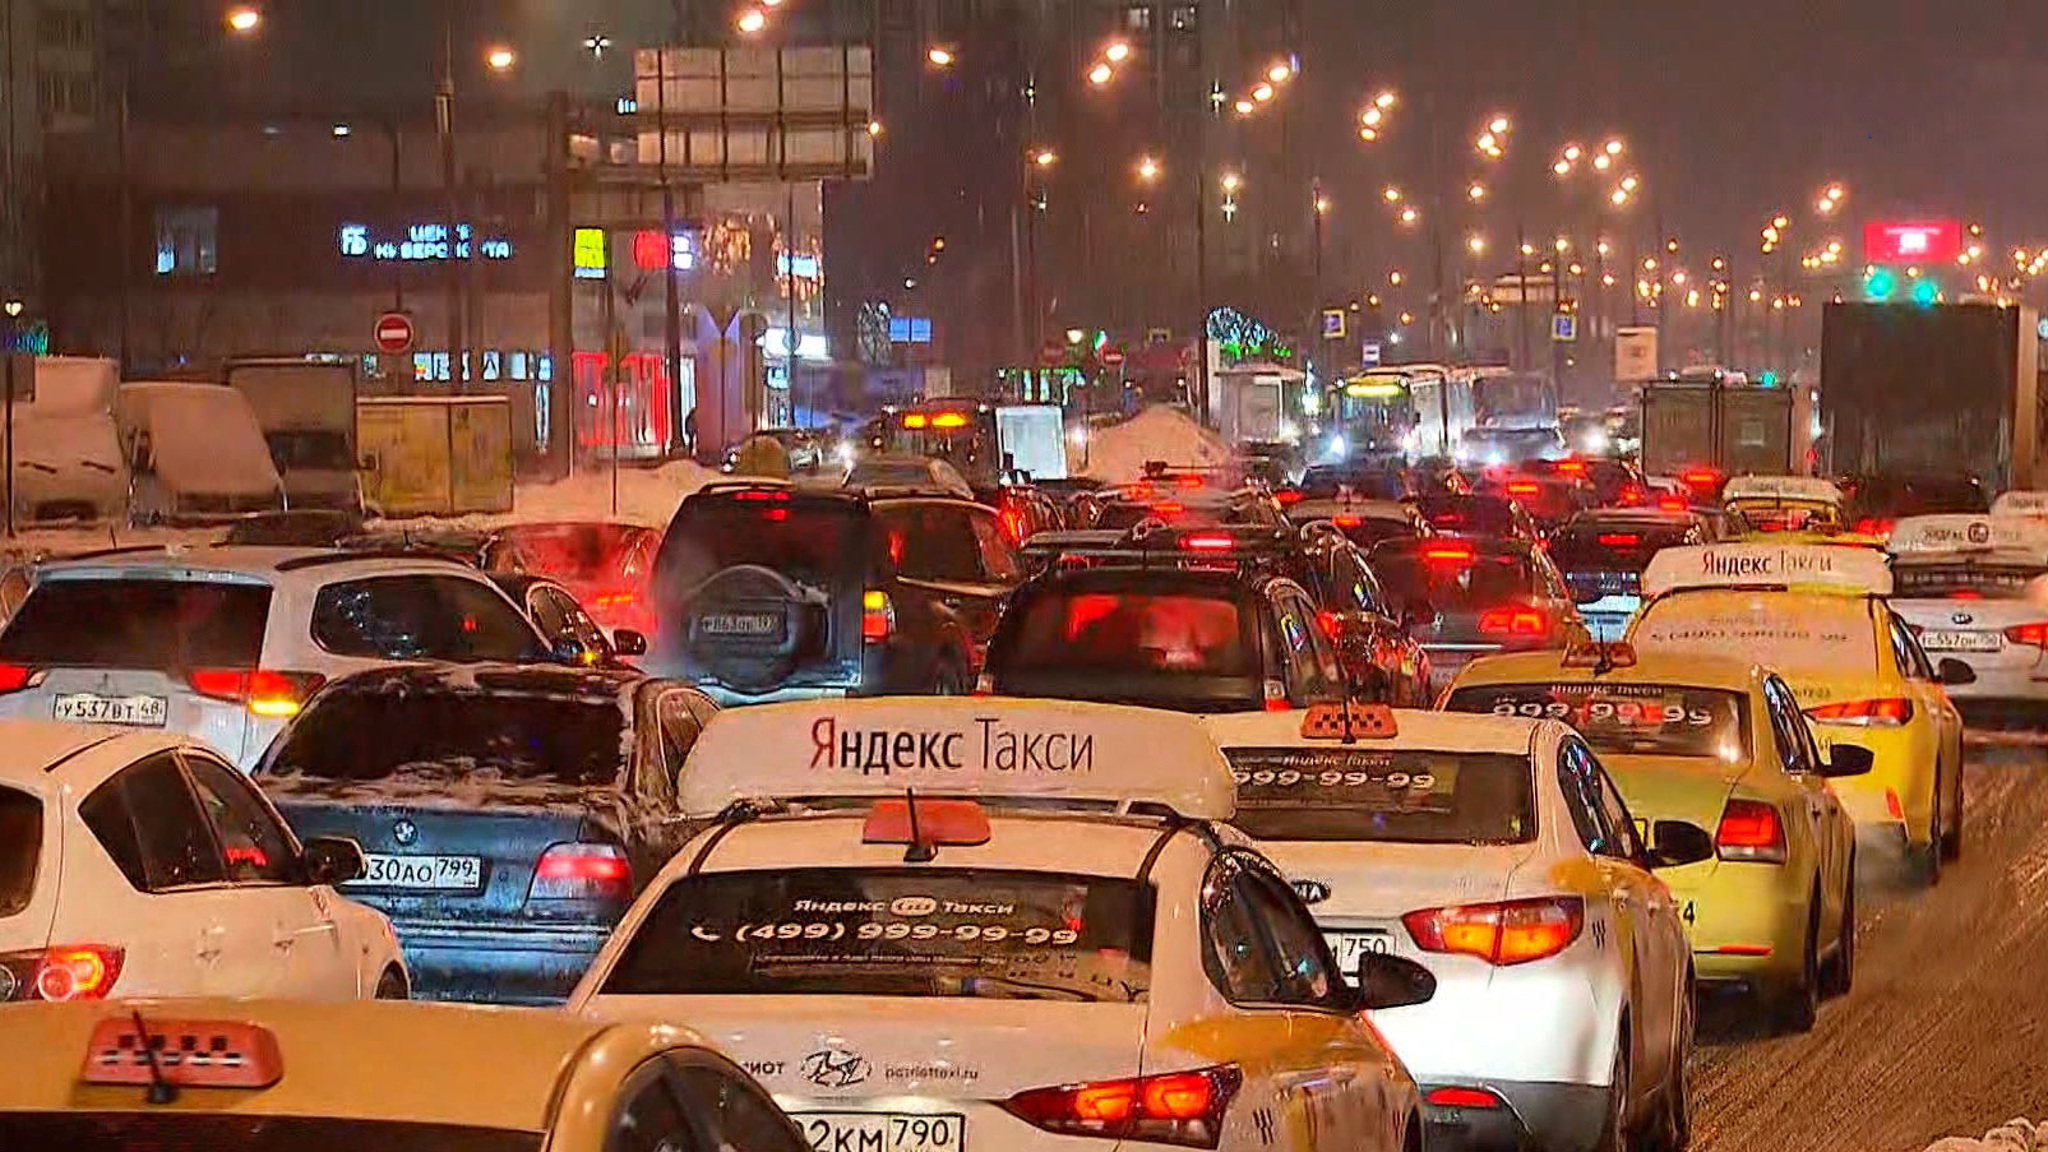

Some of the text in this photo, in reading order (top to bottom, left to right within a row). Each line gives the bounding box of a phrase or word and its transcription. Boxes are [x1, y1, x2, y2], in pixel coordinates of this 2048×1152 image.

[809, 717, 1094, 775] Яндекс Такси
[365, 859, 433, 883] 30АО
[793, 899, 885, 913] Яндекс
[942, 900, 1015, 915] Такси
[735, 922, 1079, 945] (499) 999-99-99
[798, 1119, 955, 1152] 2КМ 790
